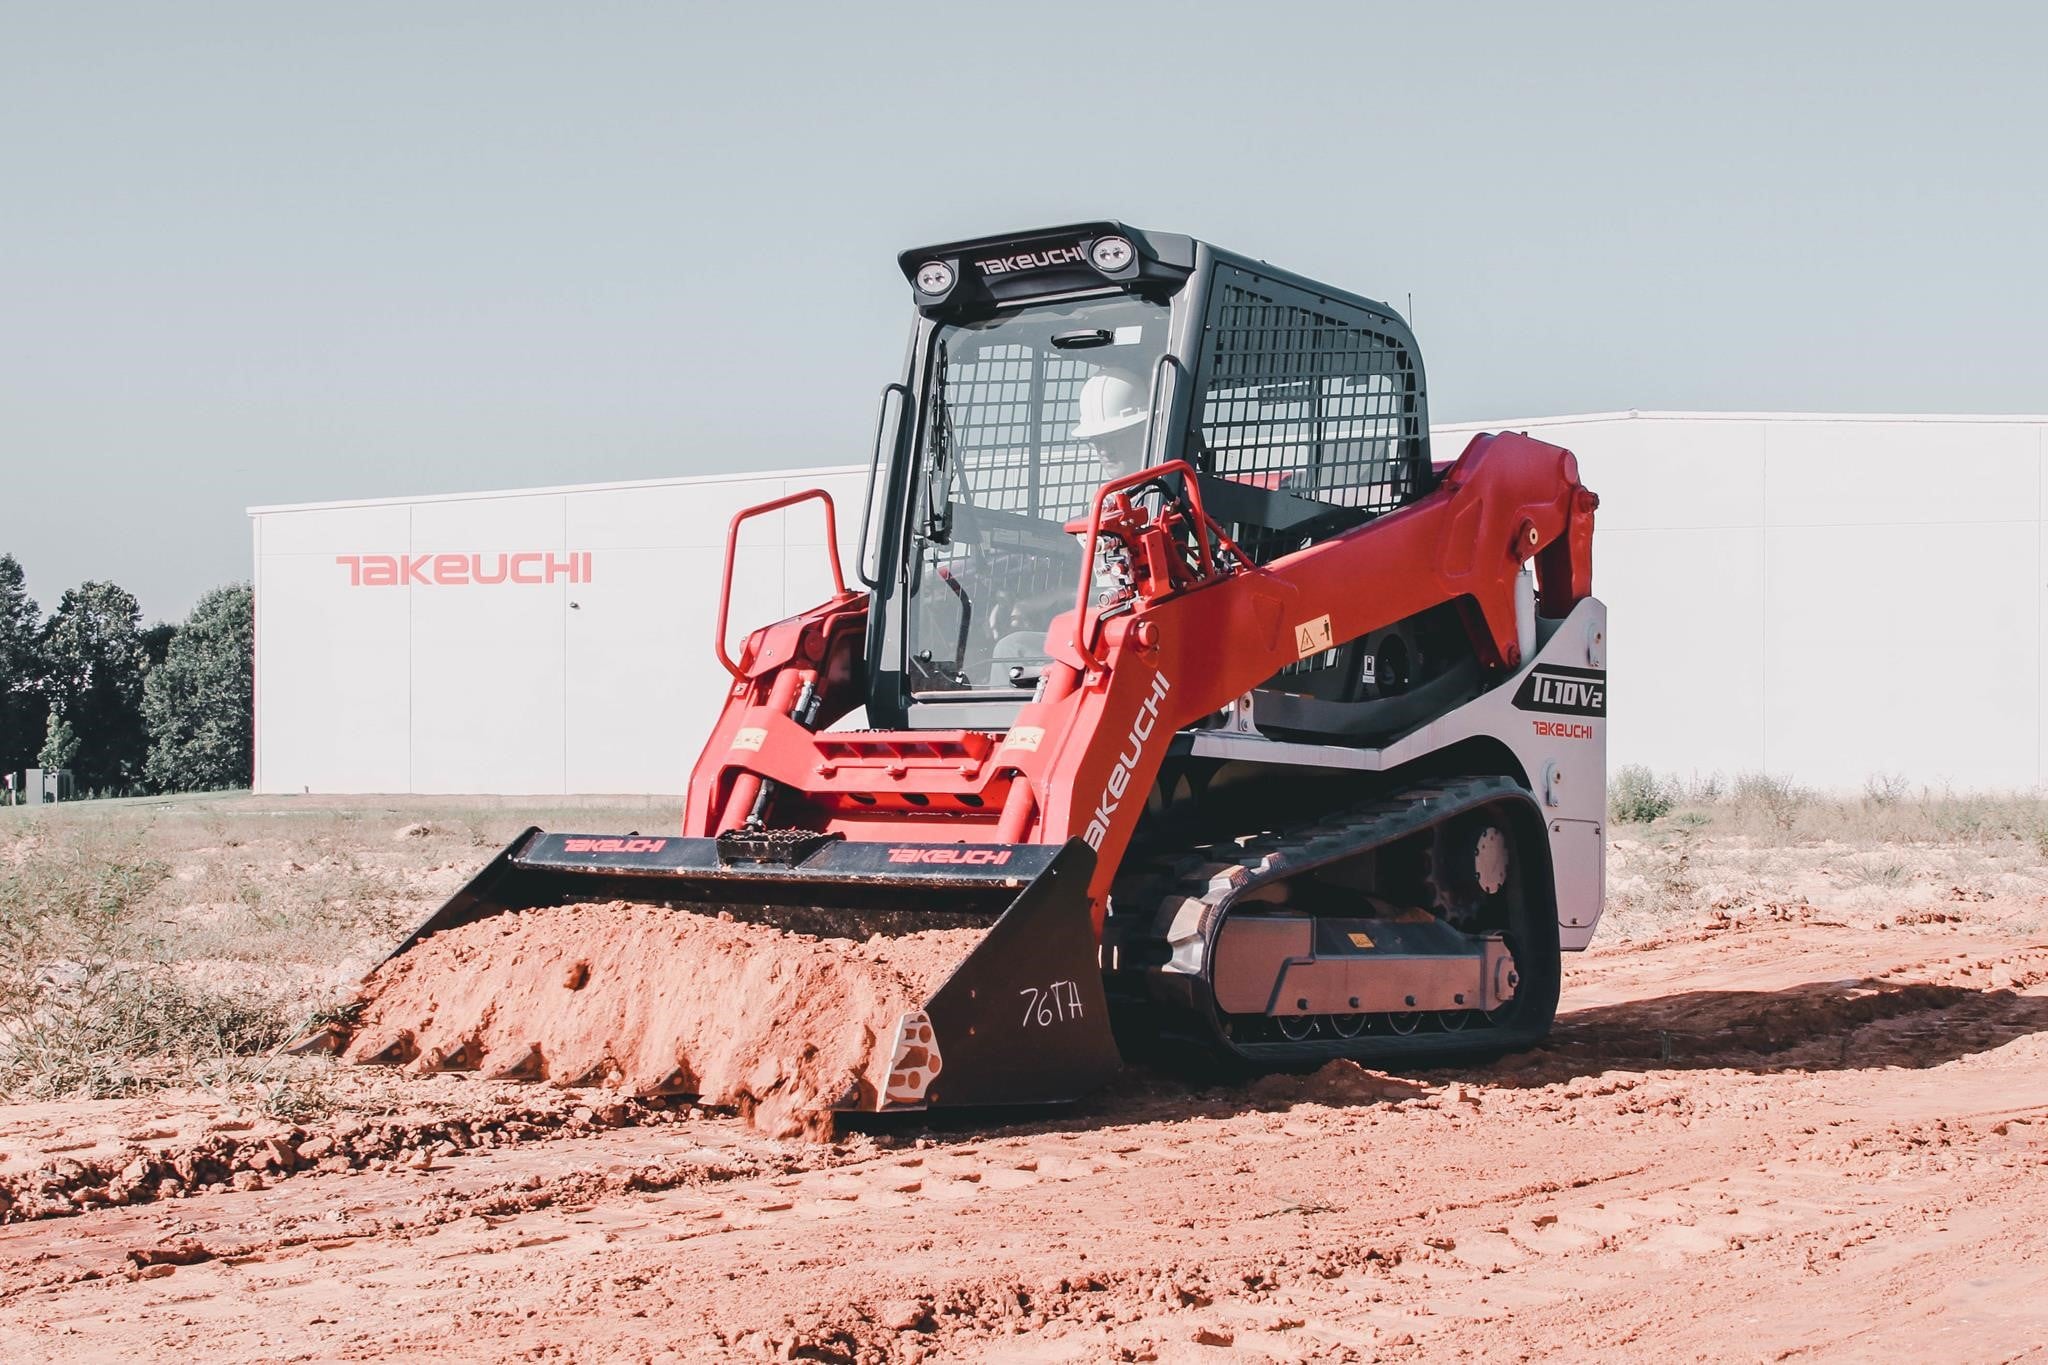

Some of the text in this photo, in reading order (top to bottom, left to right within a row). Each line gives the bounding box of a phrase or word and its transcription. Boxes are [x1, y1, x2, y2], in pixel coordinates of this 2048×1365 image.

[336, 552, 592, 586] TAKEUCHI
[1532, 672, 1604, 708] TL10V2
[1533, 721, 1592, 739] TAKEUCHI
[1083, 671, 1171, 852] AKEUCHI
[564, 839, 667, 852] TAKEUCHI
[888, 849, 1012, 864] TAKEUCHI
